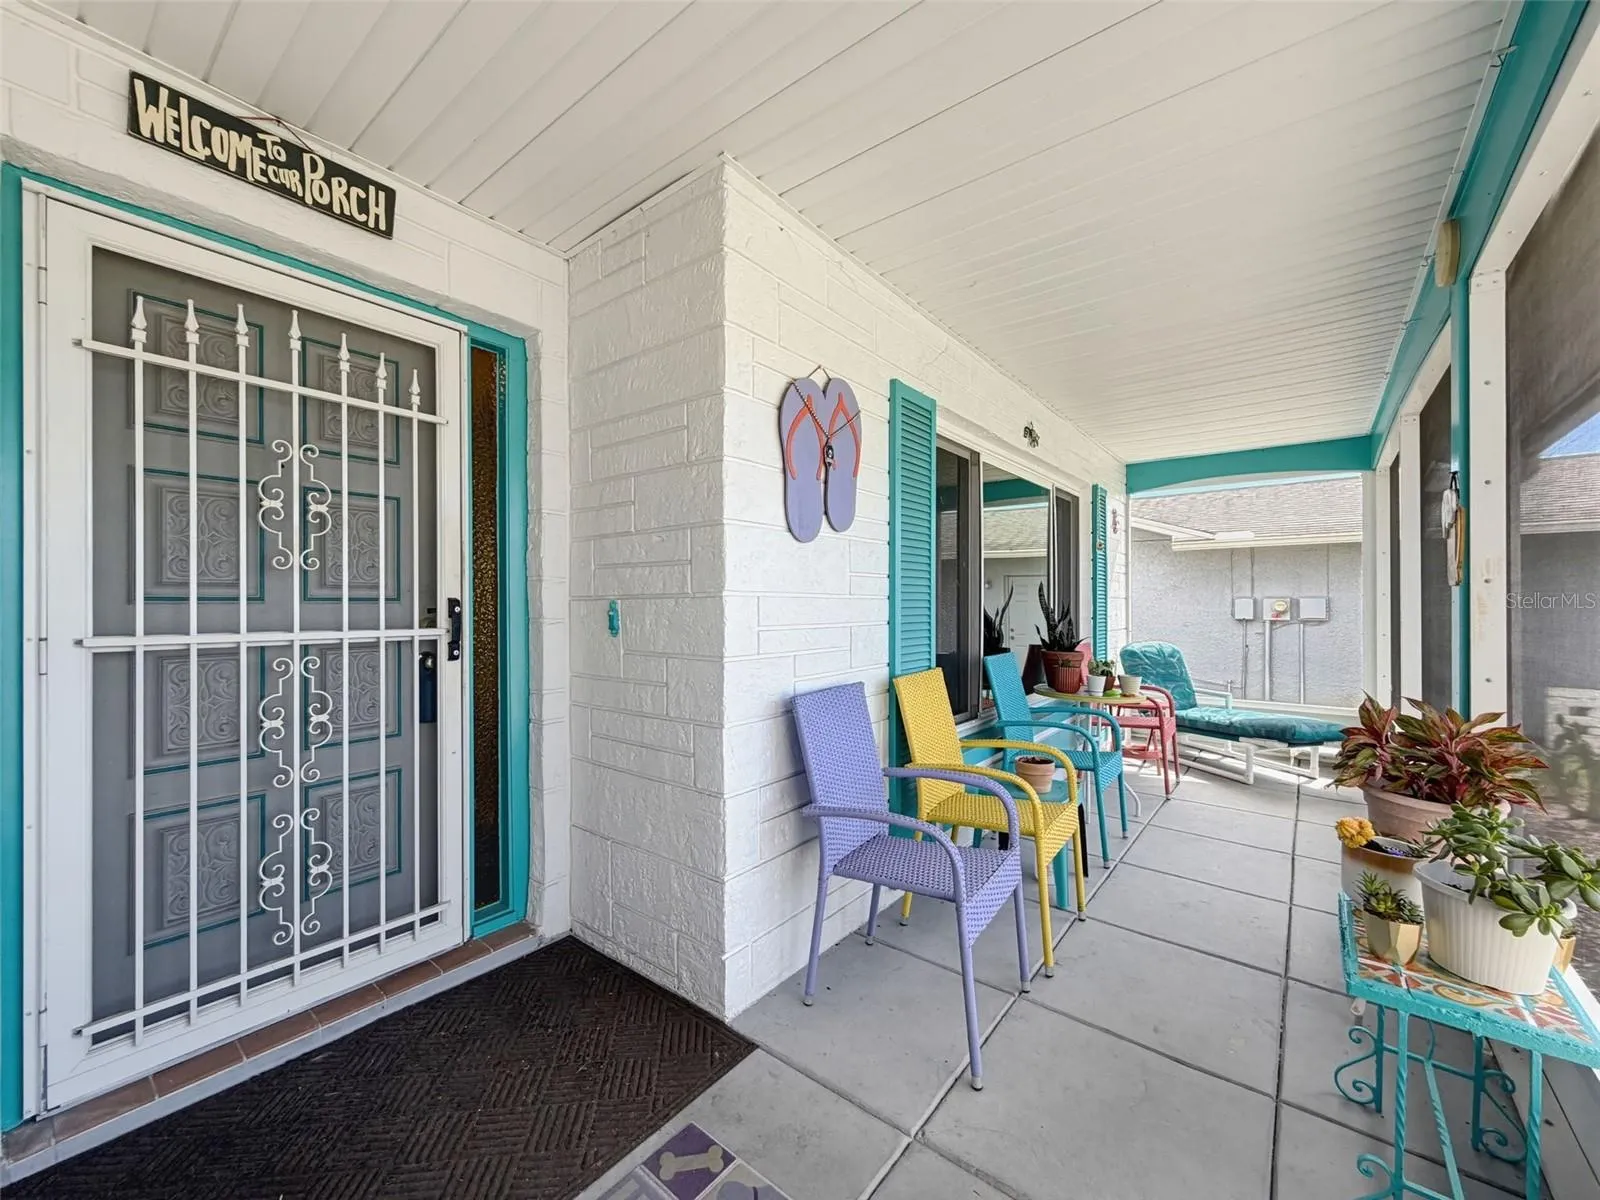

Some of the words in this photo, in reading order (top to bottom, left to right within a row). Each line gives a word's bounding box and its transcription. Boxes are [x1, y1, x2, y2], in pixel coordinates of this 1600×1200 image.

[133, 78, 269, 184] WELCOME
[256, 132, 287, 162] TO
[267, 165, 304, 197] OUR
[302, 152, 386, 231] PORCH
